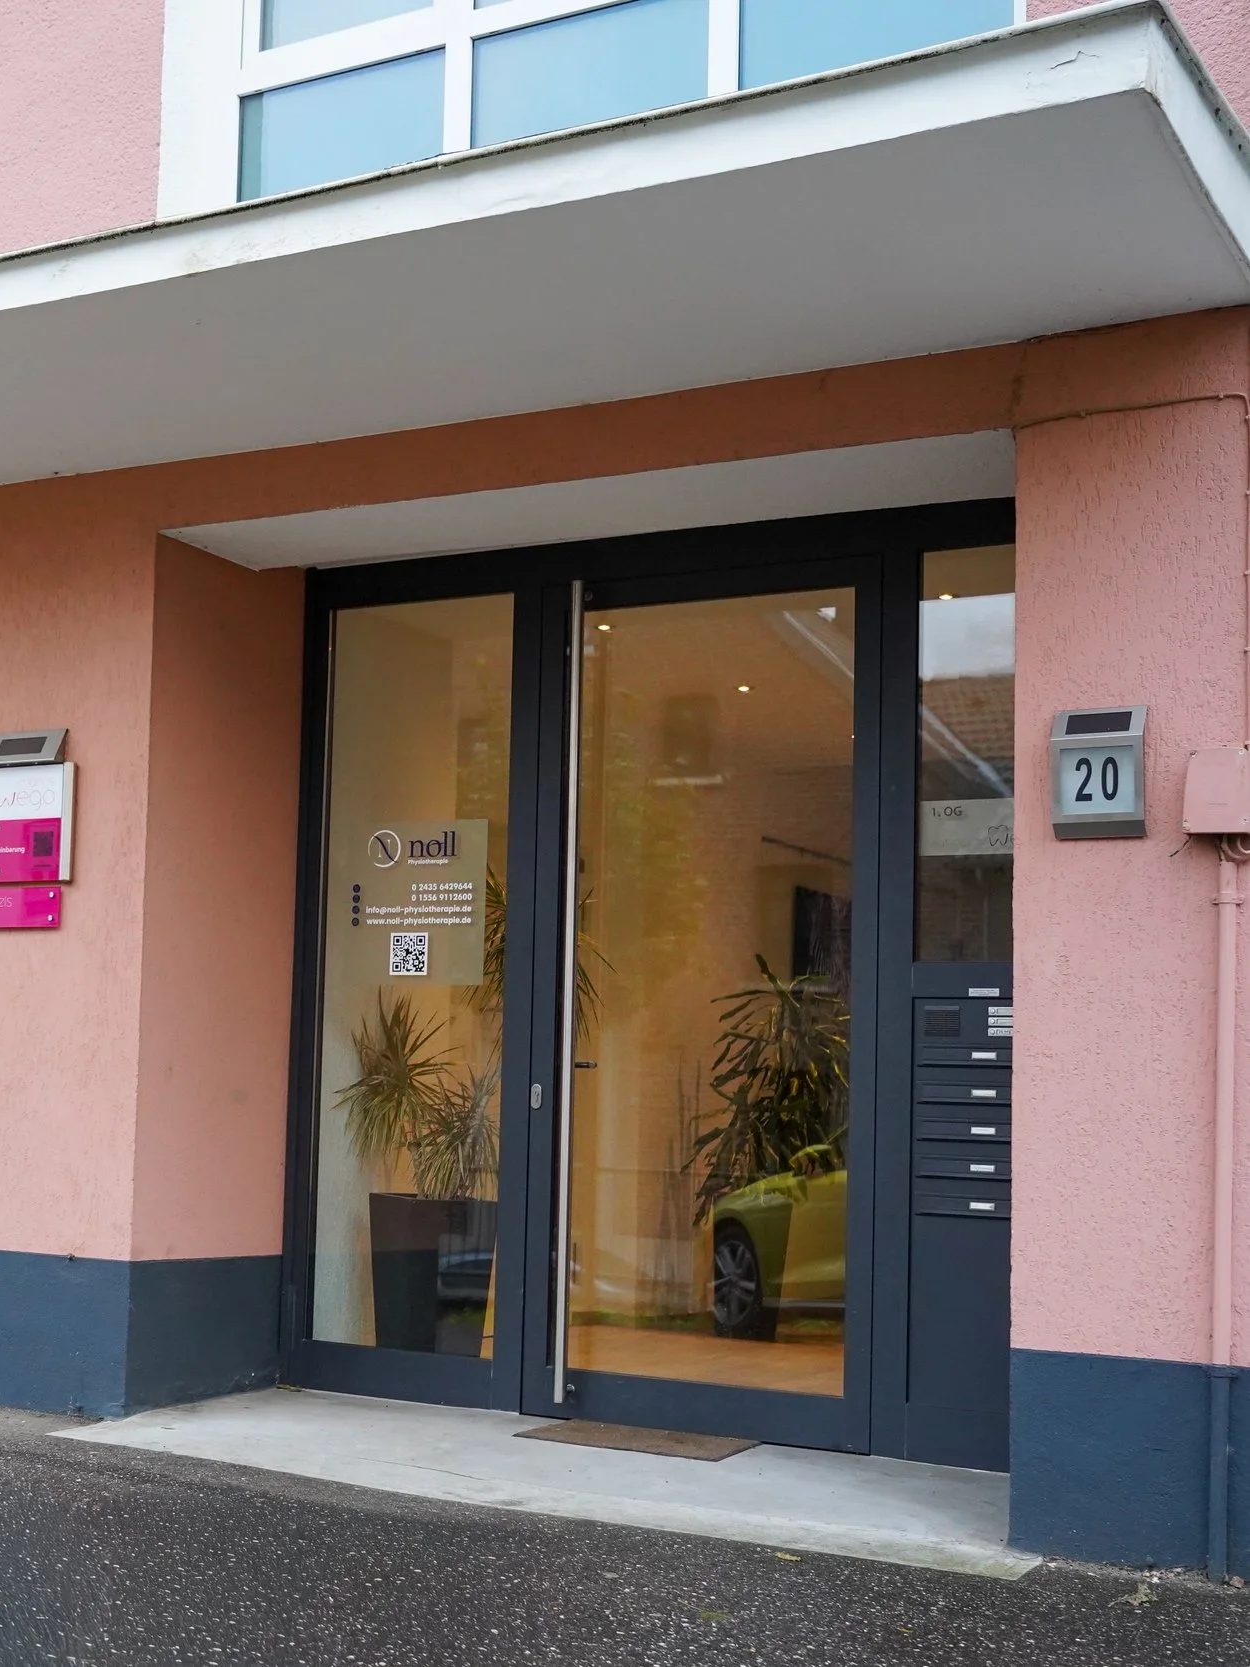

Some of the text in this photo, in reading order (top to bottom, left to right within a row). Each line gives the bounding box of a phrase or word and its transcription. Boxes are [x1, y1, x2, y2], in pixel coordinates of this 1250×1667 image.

[1075, 756, 1119, 802] 20
[943, 805, 963, 817] OG
[408, 830, 457, 858] noll
[407, 858, 449, 866] Physiotherapie
[418, 883, 438, 891] 2435
[439, 882, 473, 891] 6429644
[418, 893, 438, 902] 1556
[439, 893, 473, 901] 9112600
[365, 905, 472, 915] info@noll-physiotherapie.de
[366, 916, 472, 926] www.noll-physiotherapie.de
